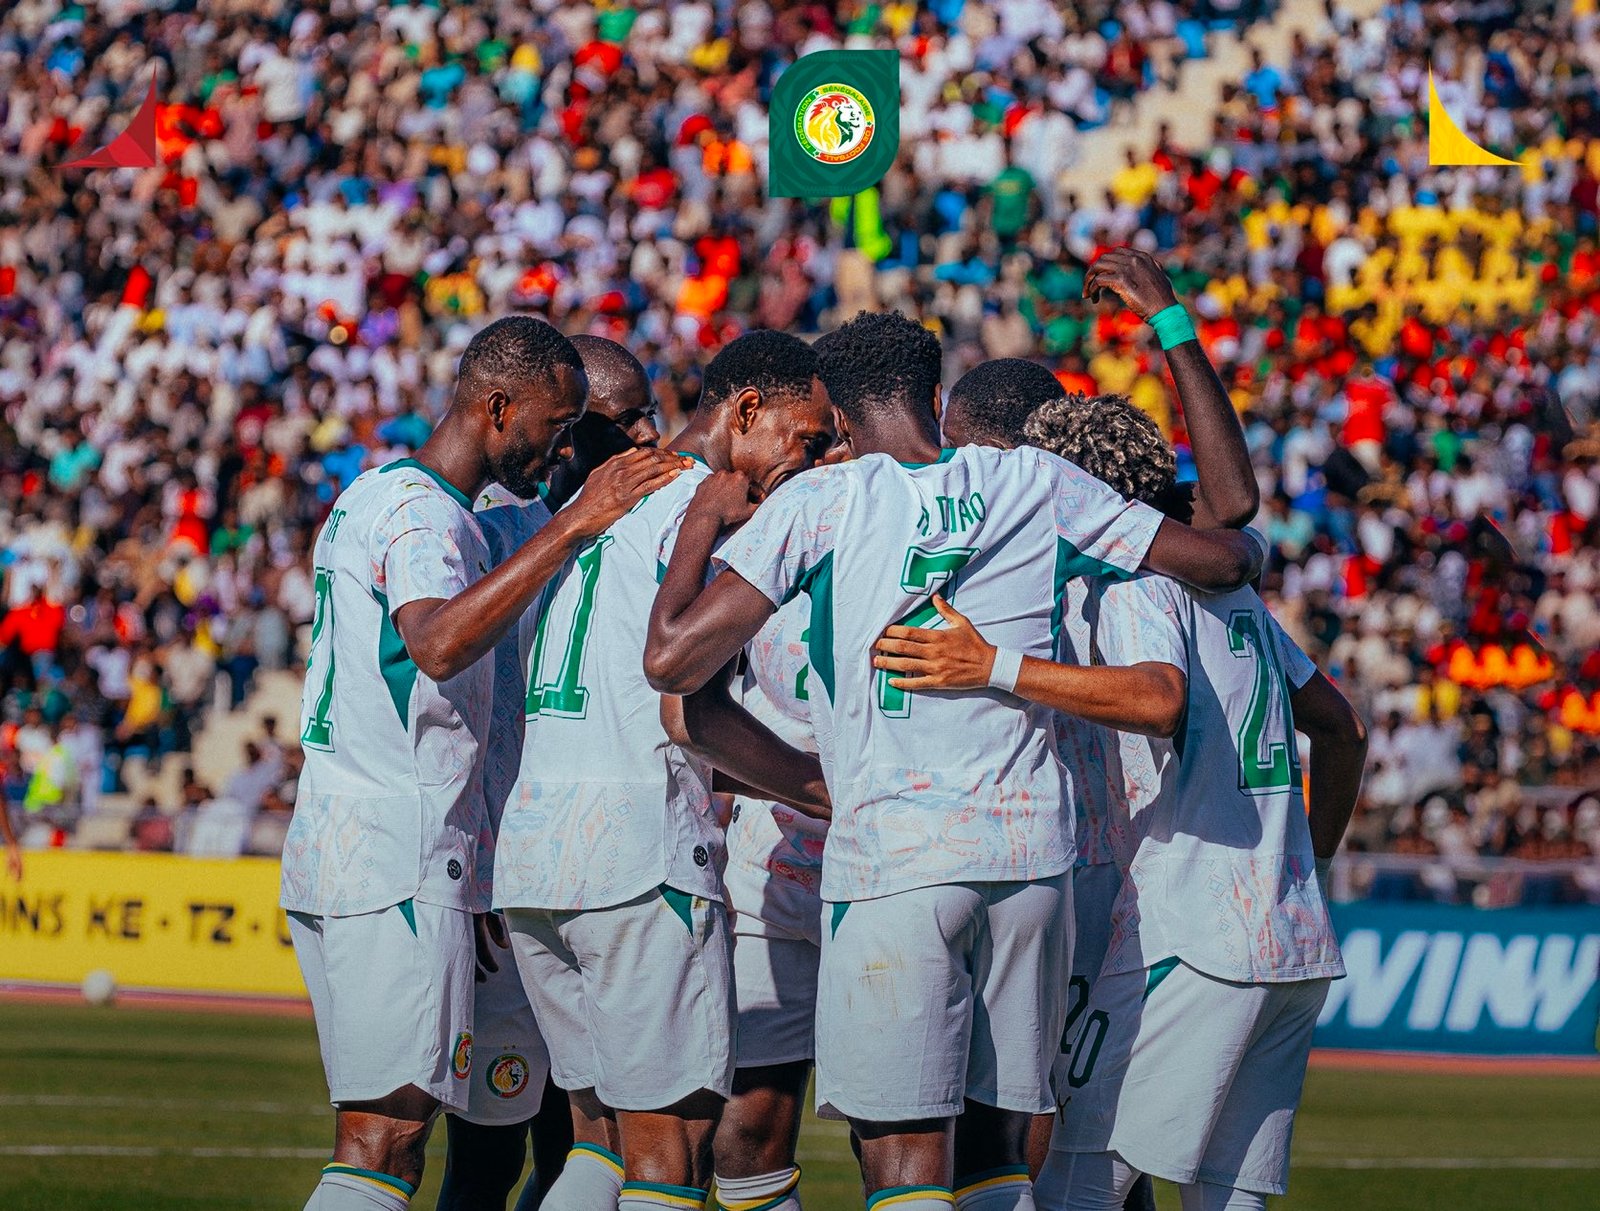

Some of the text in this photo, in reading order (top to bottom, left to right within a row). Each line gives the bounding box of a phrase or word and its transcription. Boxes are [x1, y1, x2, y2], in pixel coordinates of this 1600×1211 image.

[877, 546, 981, 719] 7
[88, 898, 142, 939] KE
[188, 902, 235, 943] TZ
[1060, 974, 1110, 1089] 20
